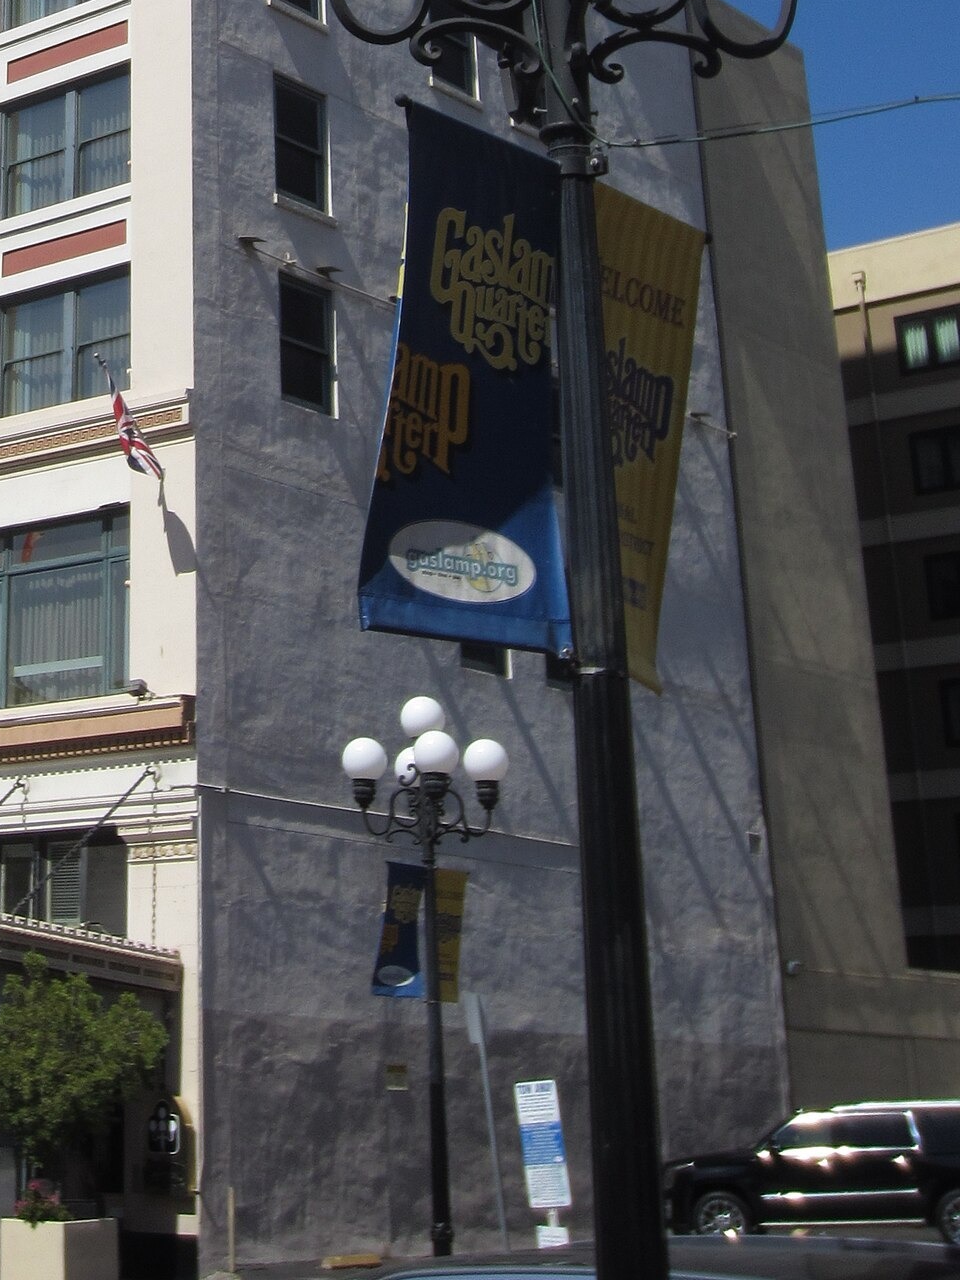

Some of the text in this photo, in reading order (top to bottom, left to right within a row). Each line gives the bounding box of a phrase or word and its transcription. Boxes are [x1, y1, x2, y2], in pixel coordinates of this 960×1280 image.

[430, 207, 555, 308] Gaslam
[600, 264, 685, 327] ELCOME
[606, 337, 673, 464] slamp
[407, 550, 516, 584] gaslamp.org
